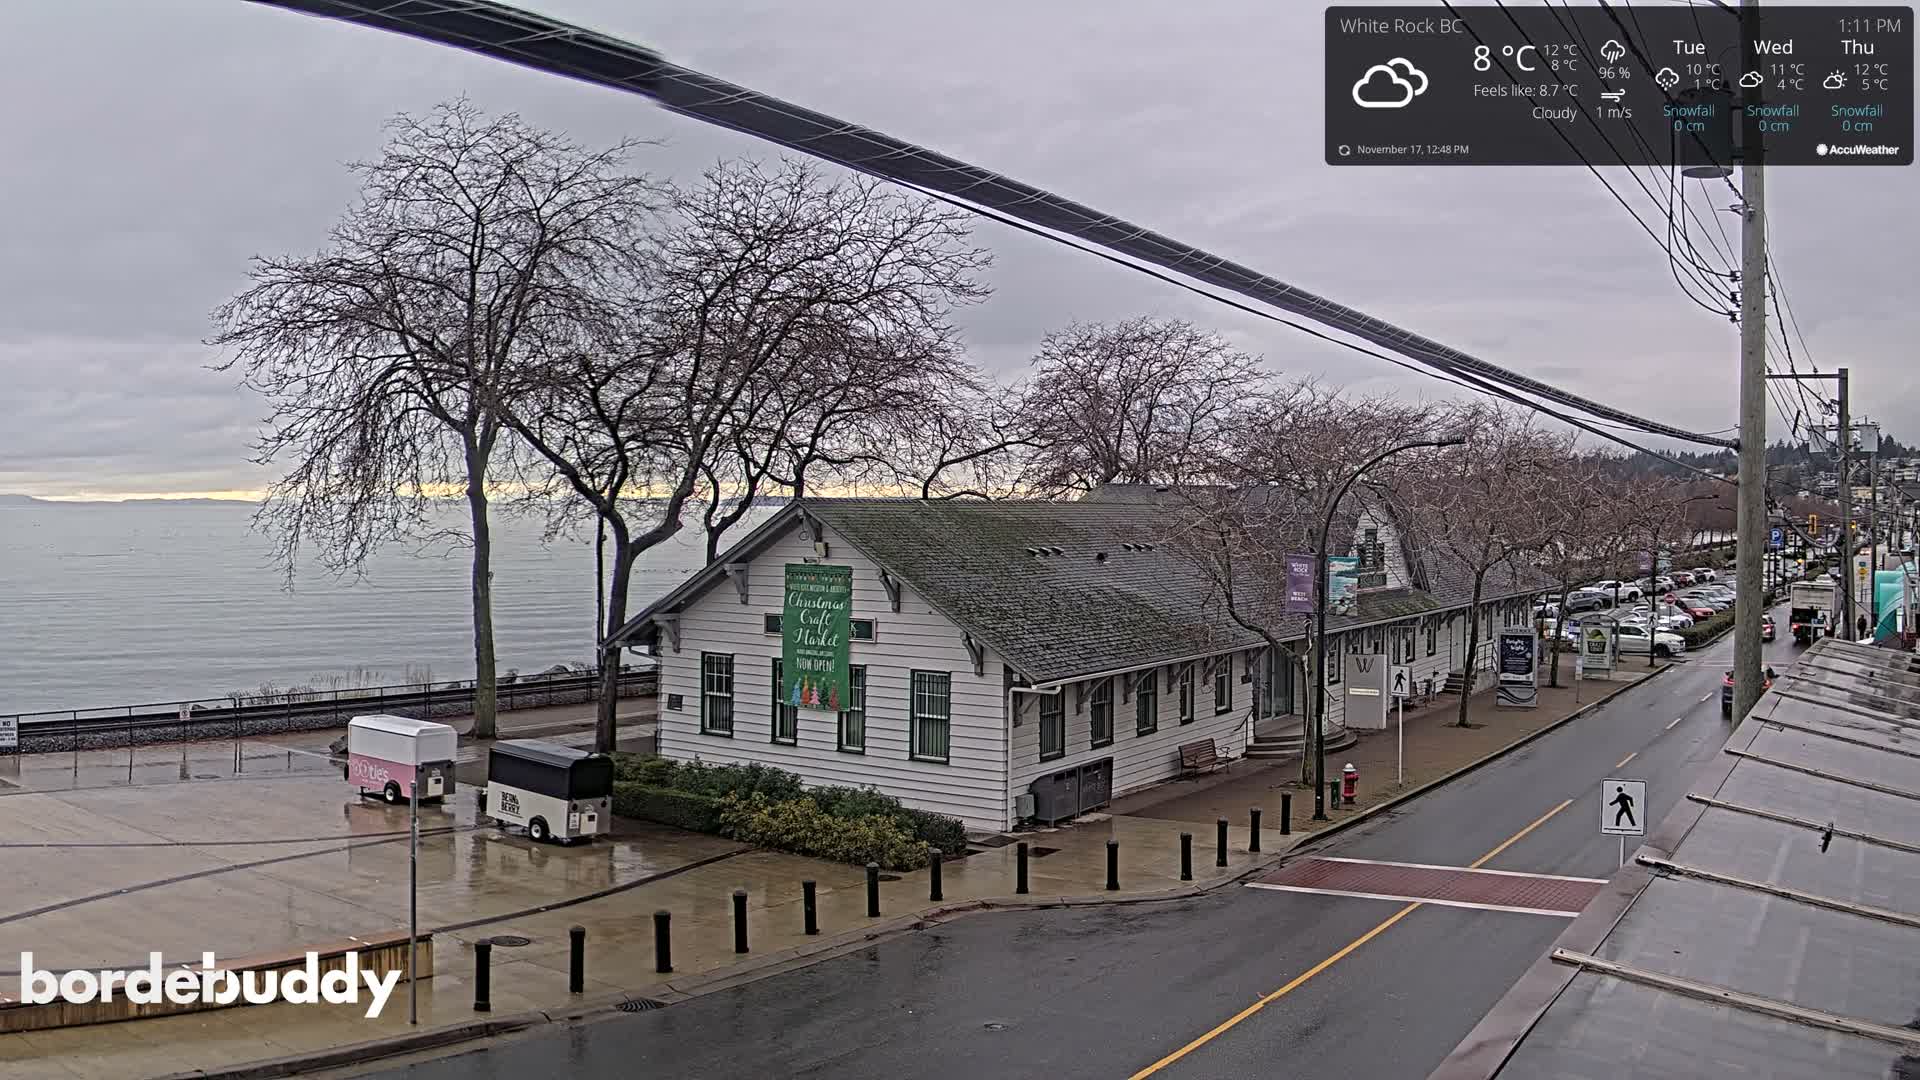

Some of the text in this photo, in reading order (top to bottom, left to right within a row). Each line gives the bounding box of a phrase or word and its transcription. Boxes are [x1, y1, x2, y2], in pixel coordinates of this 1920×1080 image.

[788, 591, 845, 610] Christmas
[800, 608, 832, 635] Craft
[793, 627, 840, 648] Market
